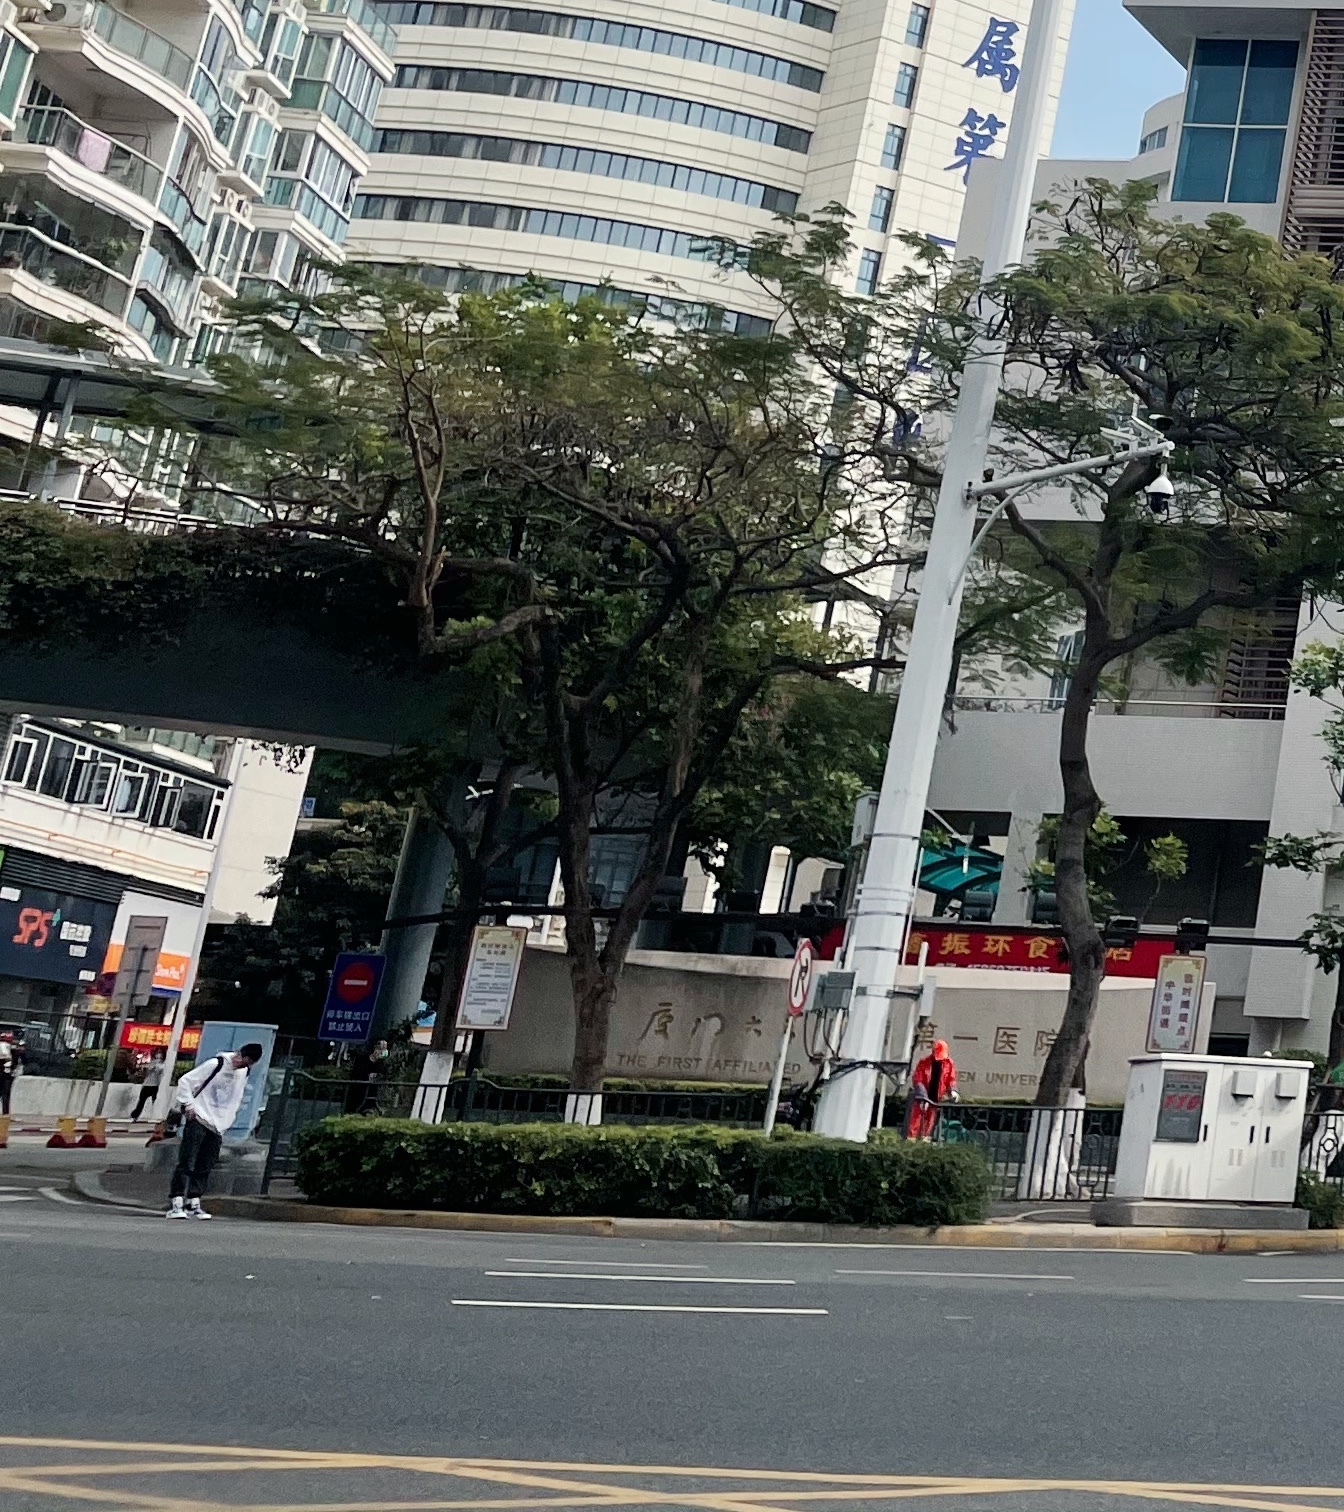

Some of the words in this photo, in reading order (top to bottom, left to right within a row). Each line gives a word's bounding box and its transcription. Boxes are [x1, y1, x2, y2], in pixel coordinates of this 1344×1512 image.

[617, 1053, 648, 1067] THE
[657, 1055, 703, 1071] FIRST
[712, 1058, 802, 1074] AFFILIAED
